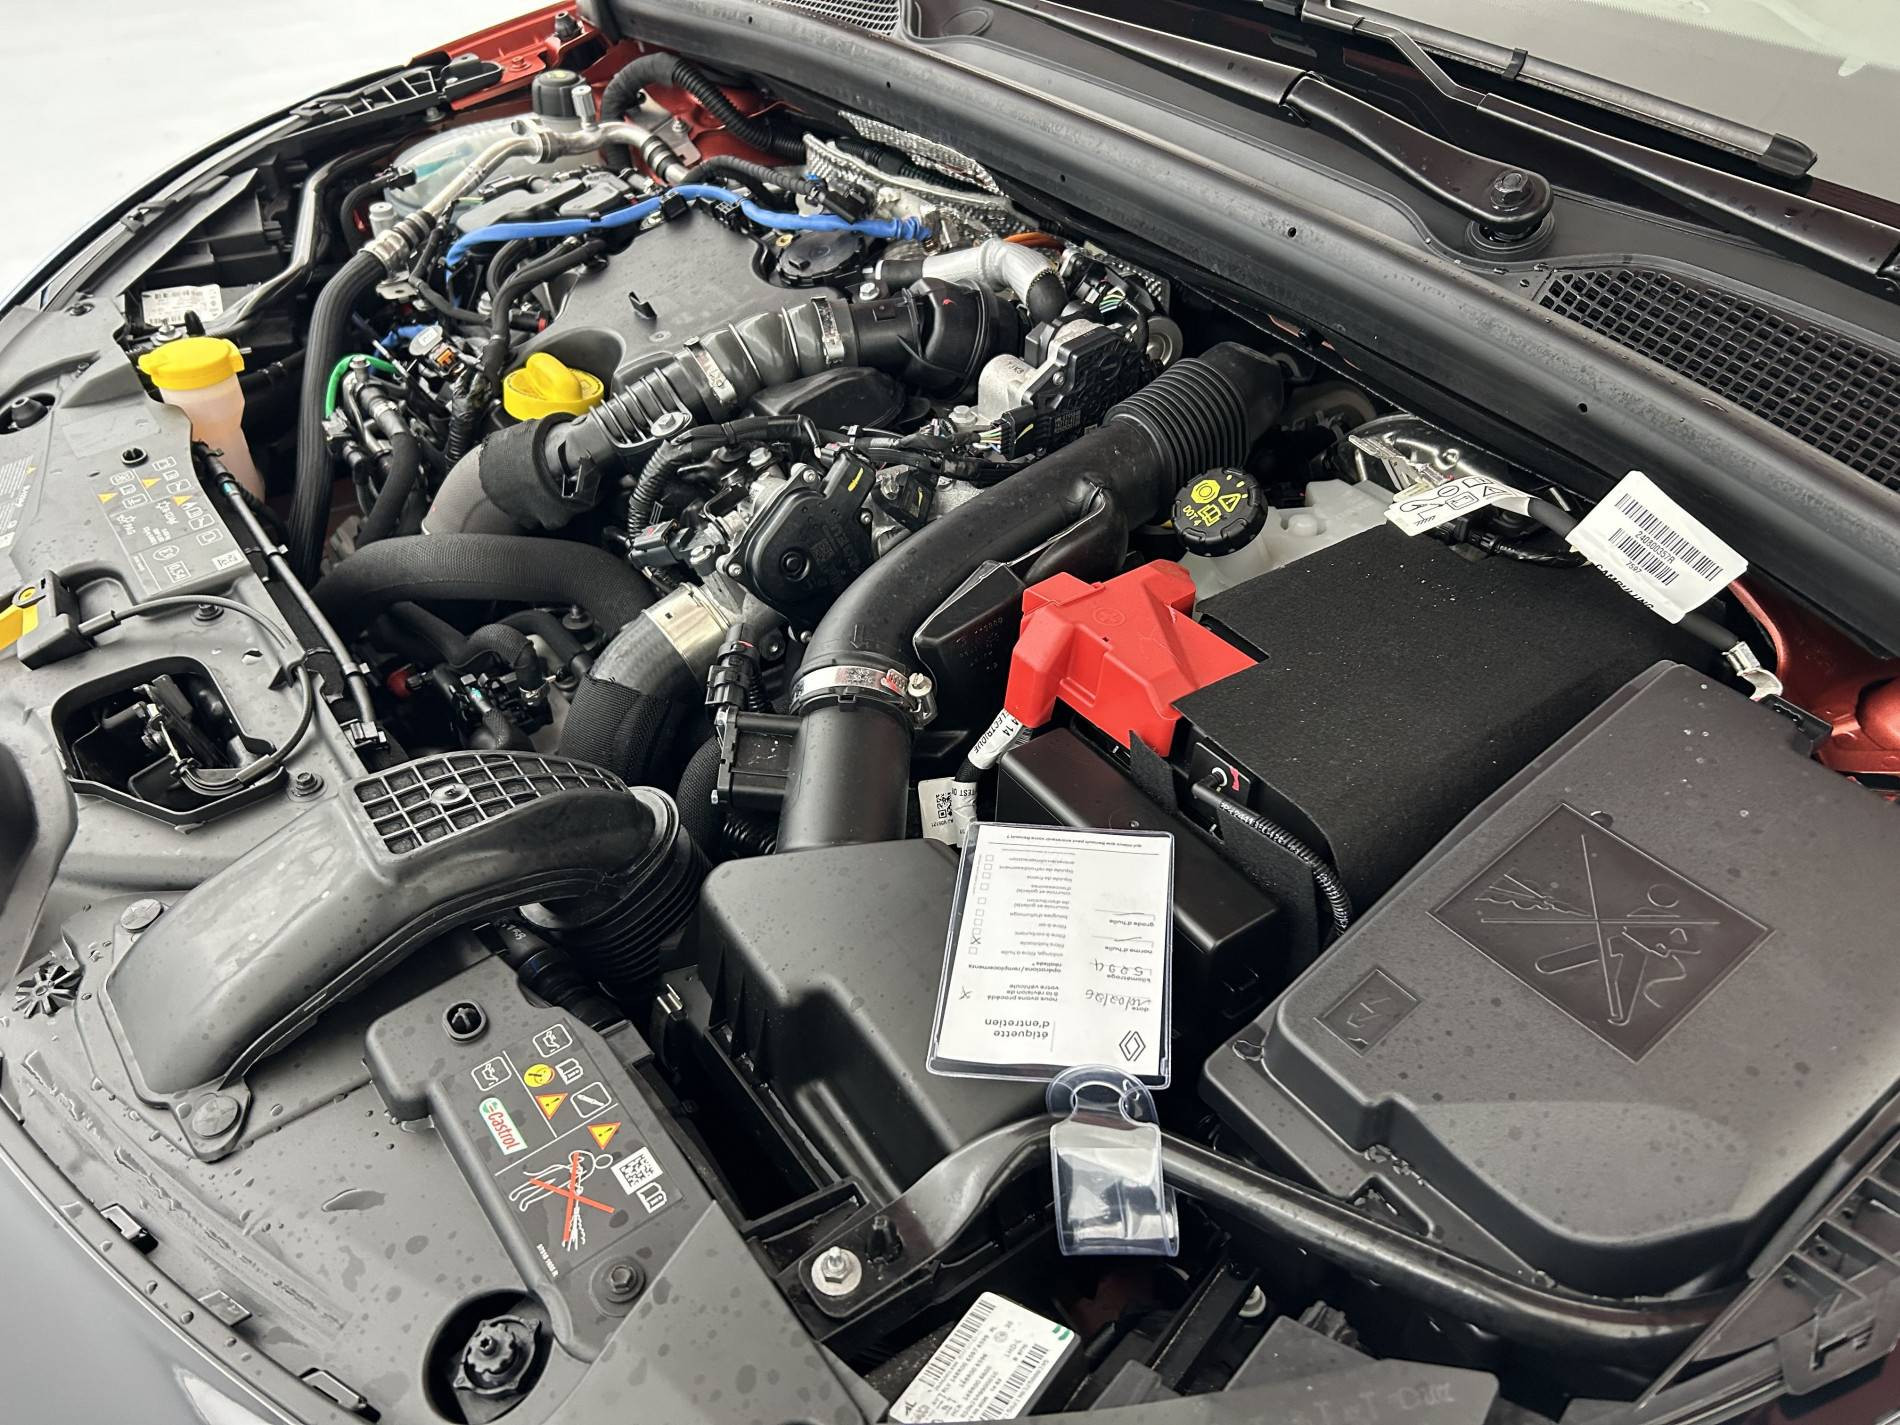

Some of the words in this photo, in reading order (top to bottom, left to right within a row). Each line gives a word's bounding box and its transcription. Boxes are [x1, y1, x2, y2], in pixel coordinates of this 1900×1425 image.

[1182, 504, 1199, 520] DOT
[1193, 518, 1202, 528] 4
[1634, 529, 1676, 566] 240800357R
[1625, 560, 1643, 576] 7597
[960, 788, 975, 796] TEST
[984, 1018, 1050, 1029] d'entretien
[993, 1029, 1049, 1040] étiquette
[487, 1109, 521, 1151] Castrol
